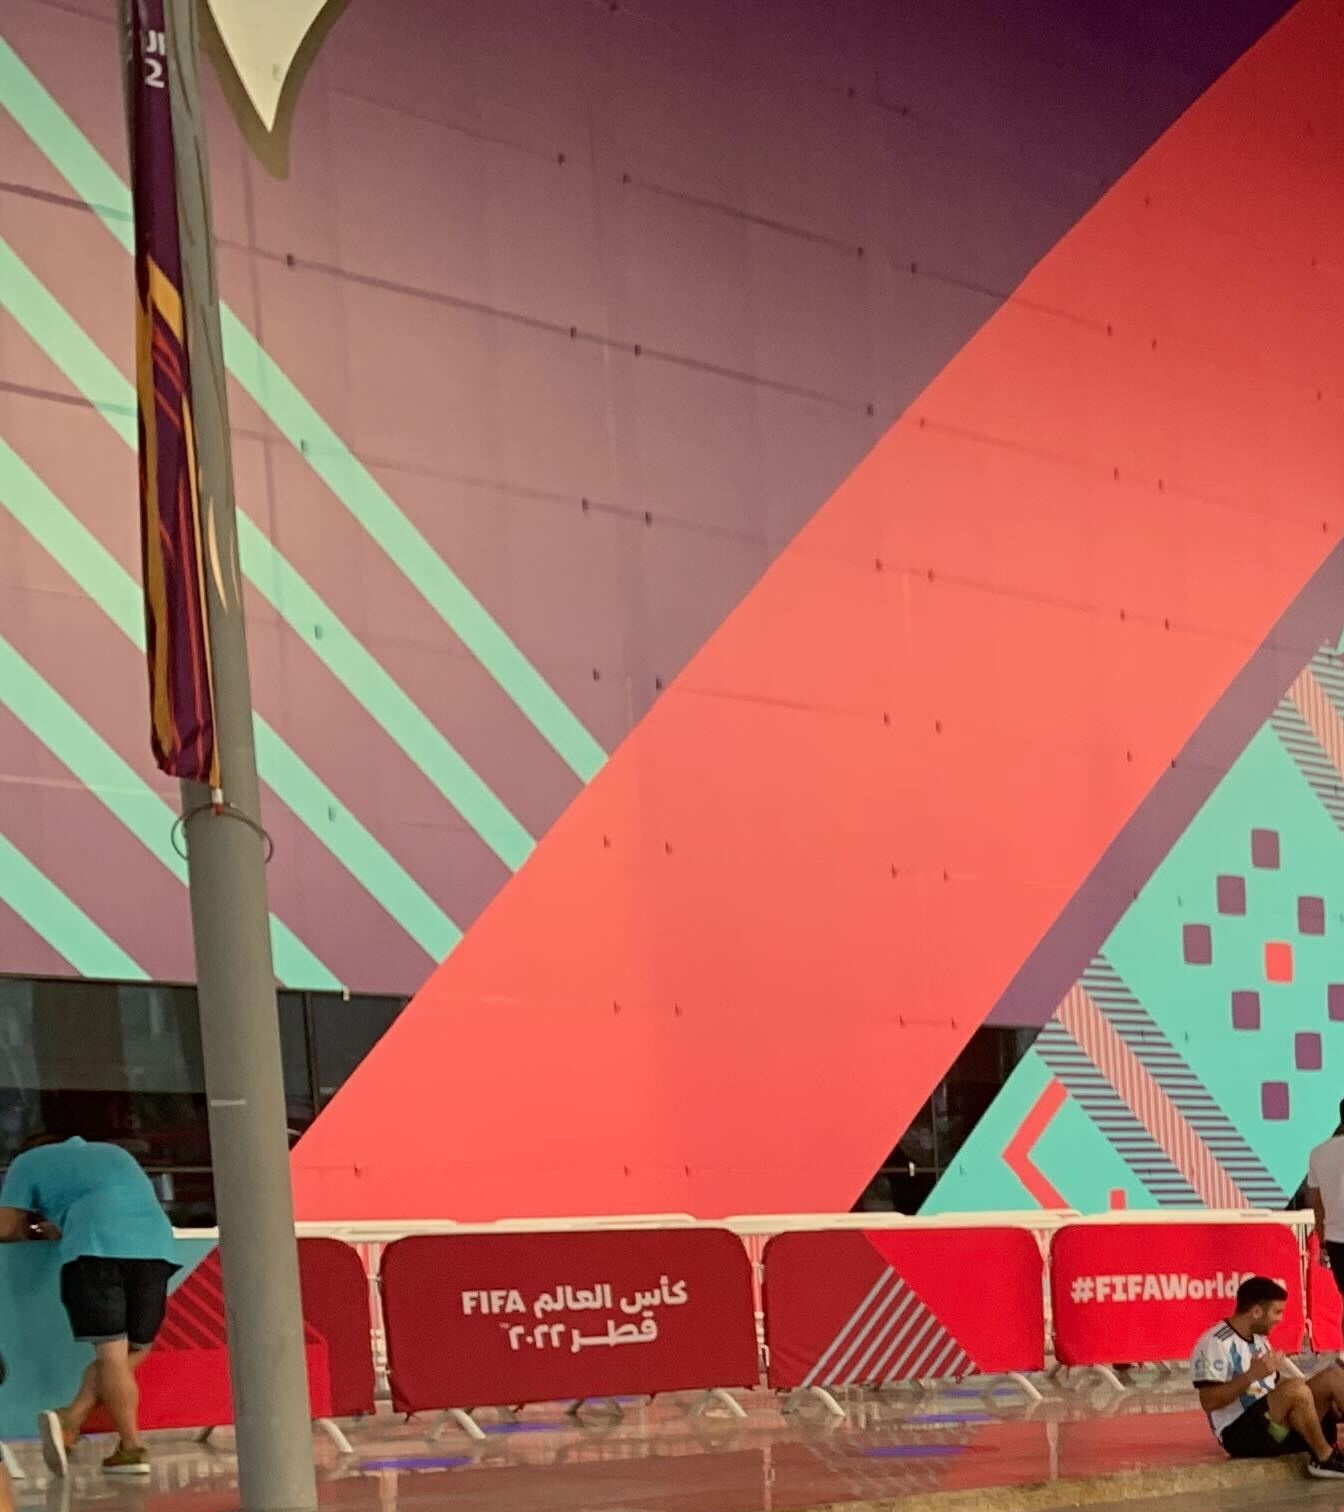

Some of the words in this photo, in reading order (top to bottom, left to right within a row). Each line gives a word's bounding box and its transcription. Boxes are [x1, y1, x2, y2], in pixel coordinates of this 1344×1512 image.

[461, 1289, 527, 1315] FIFA
[533, 1283, 613, 1319] العالم
[619, 1275, 688, 1314] كأس
[1070, 1271, 1287, 1304] #FIFAWorld
[570, 1310, 658, 1353] قطر
